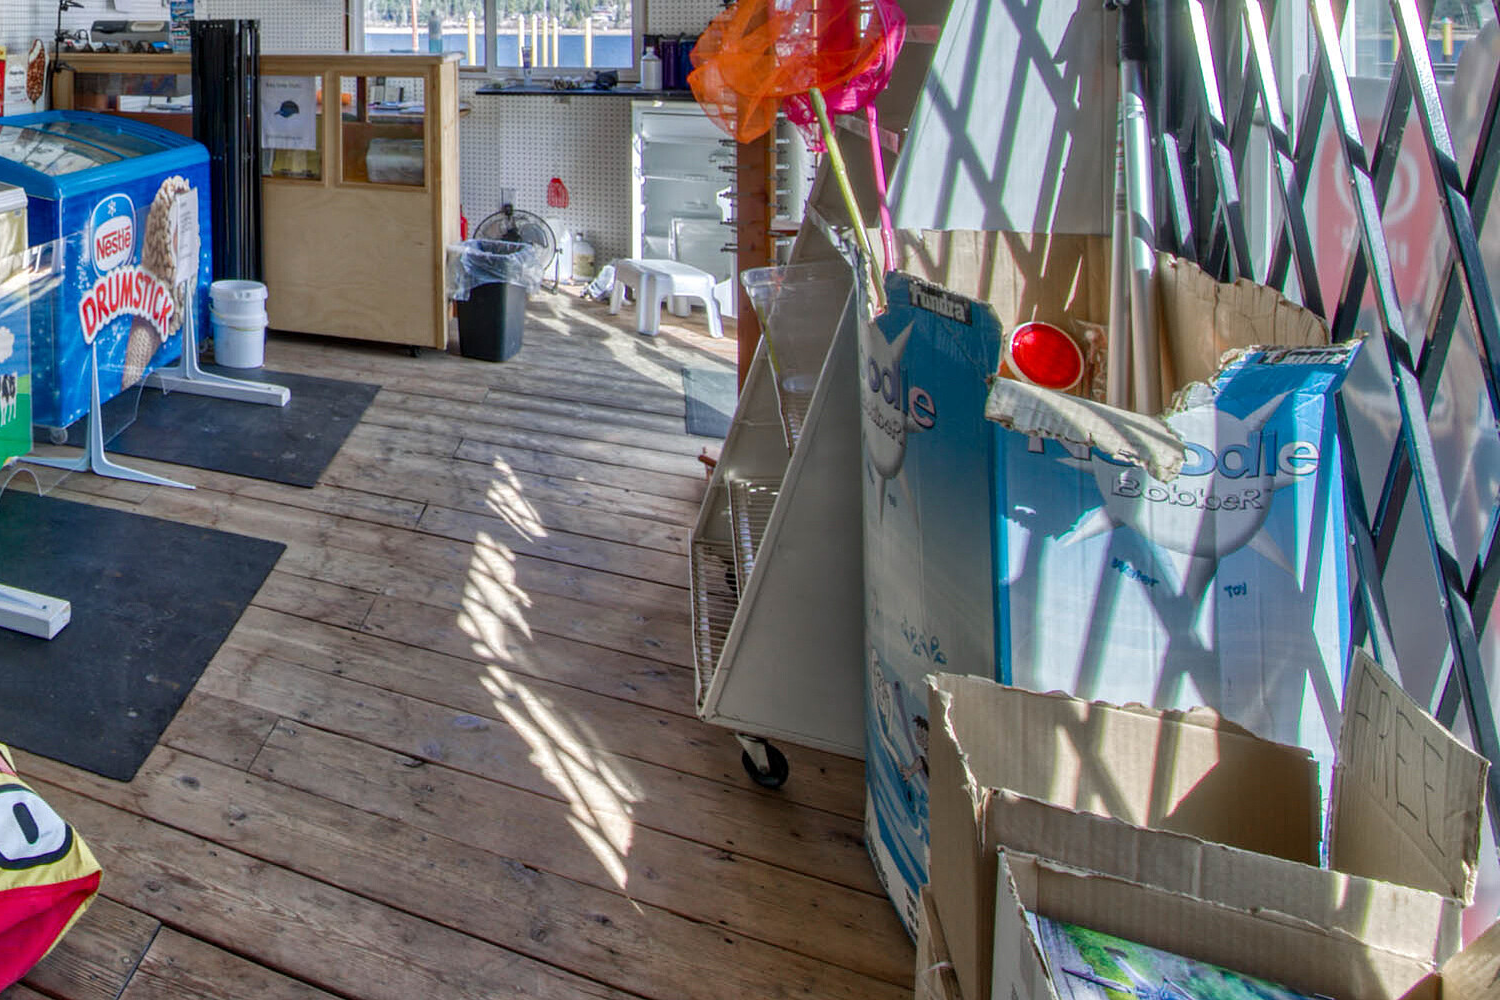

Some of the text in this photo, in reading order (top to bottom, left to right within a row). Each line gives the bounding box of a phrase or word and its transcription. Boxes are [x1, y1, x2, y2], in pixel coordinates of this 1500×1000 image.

[82, 270, 173, 338] DRUMSTICK
[866, 356, 937, 430] odle
[1027, 429, 1322, 480] odle
[1351, 663, 1446, 858] FREE
